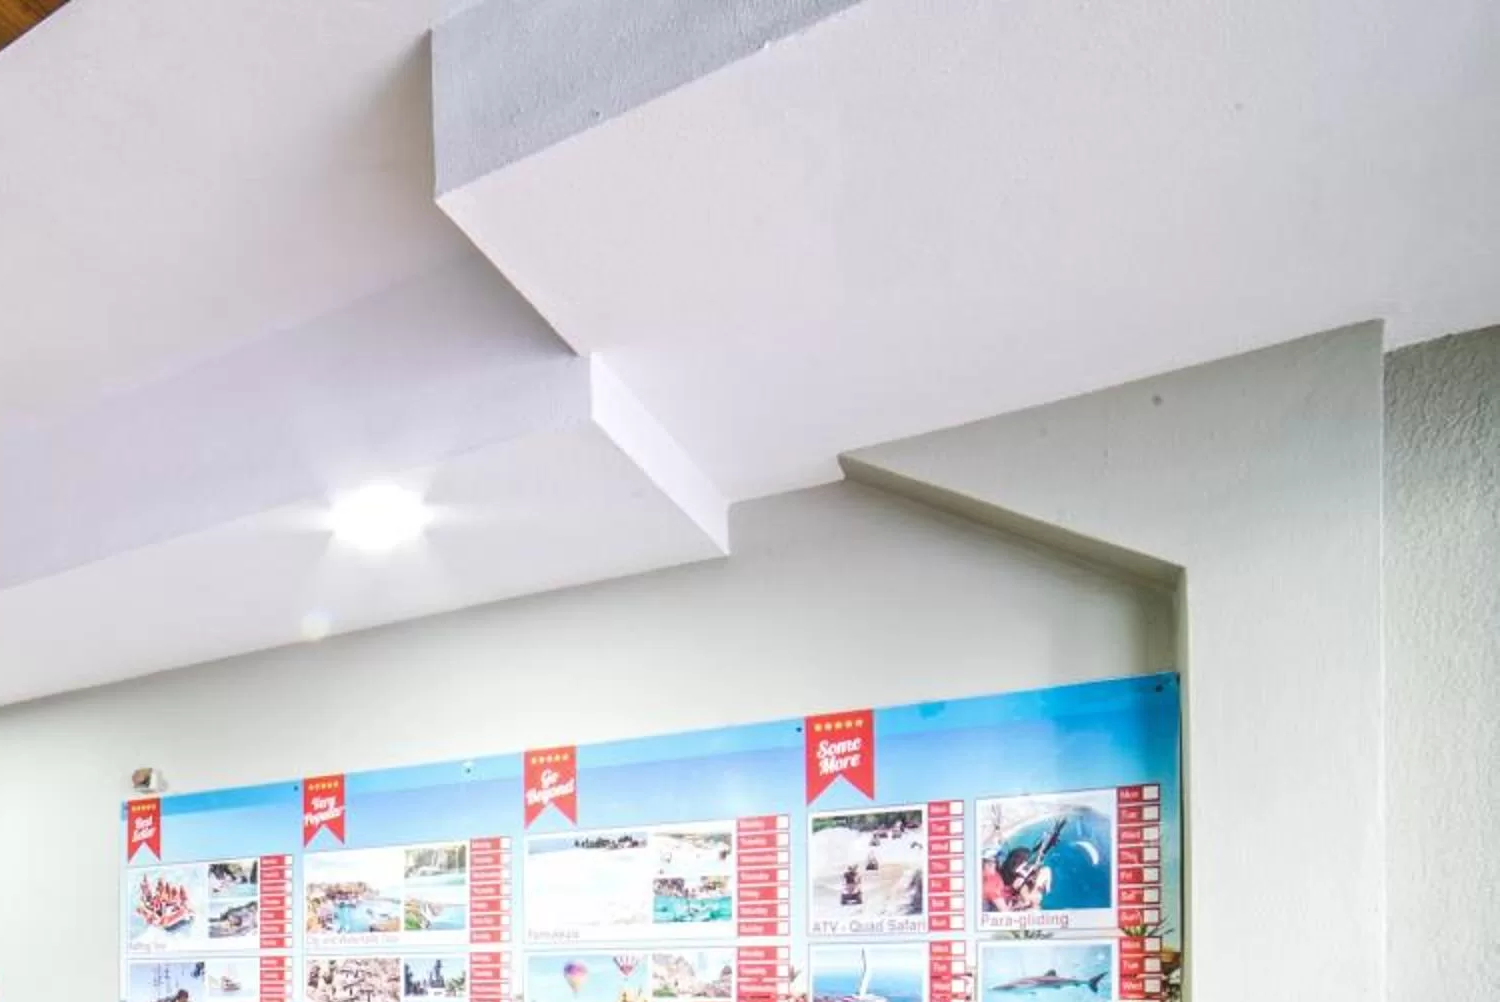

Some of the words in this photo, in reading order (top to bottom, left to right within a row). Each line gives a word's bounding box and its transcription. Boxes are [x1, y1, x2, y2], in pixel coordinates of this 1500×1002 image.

[817, 737, 862, 759] Some
[819, 754, 861, 776] More
[541, 769, 559, 789] Go
[812, 920, 838, 932] ATV
[849, 918, 885, 932] Quad
[981, 913, 1069, 929] Para-gliding
